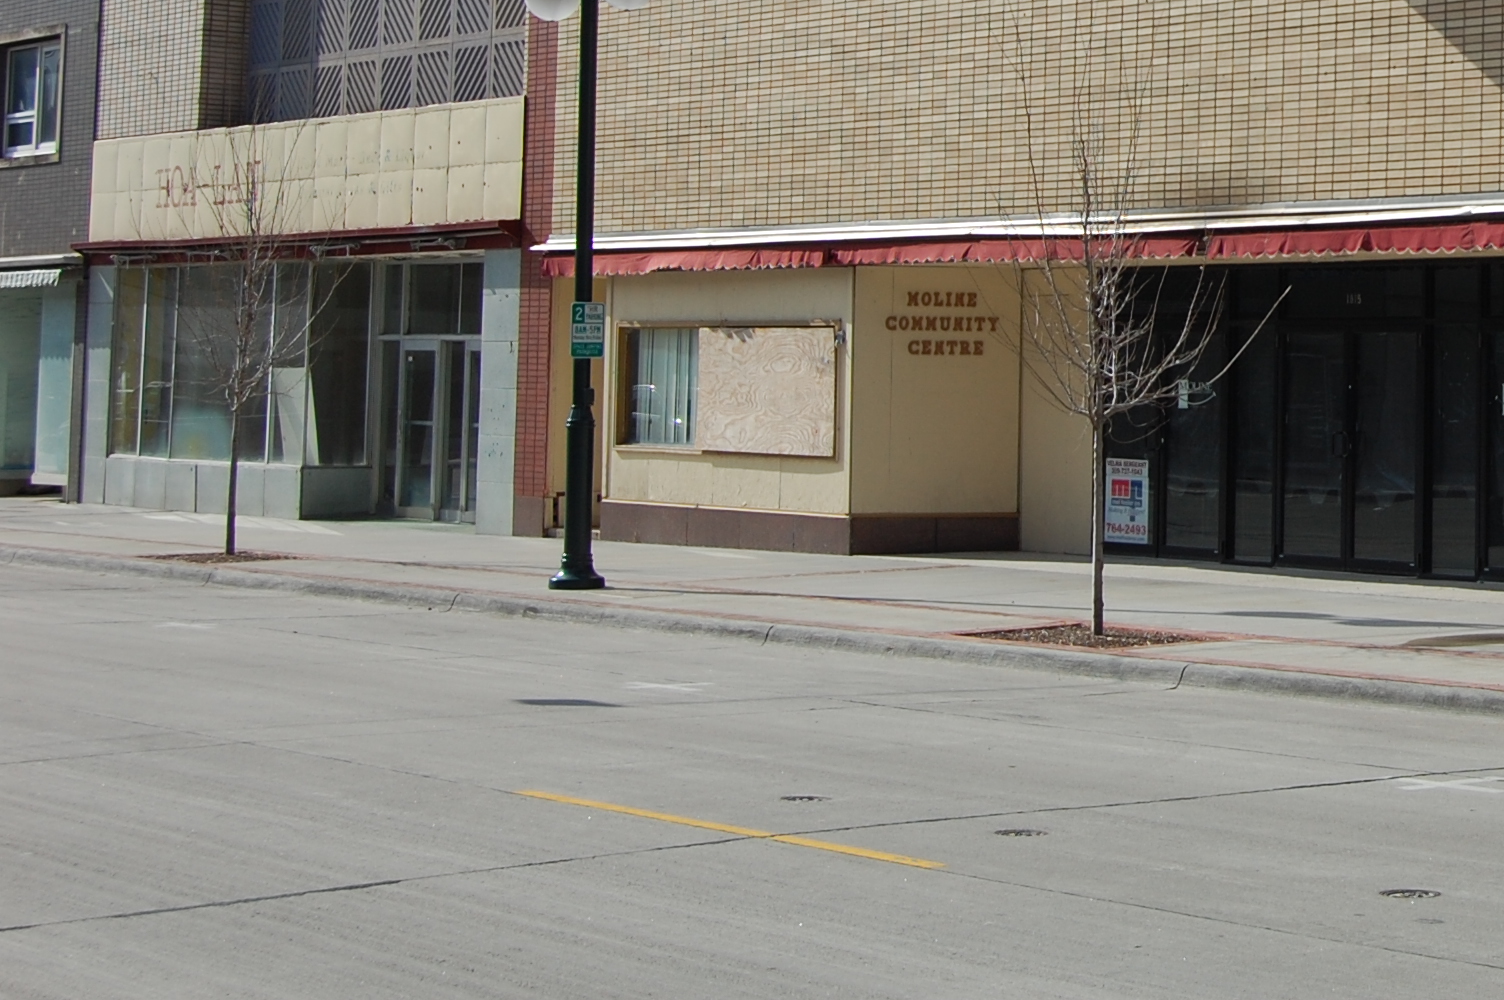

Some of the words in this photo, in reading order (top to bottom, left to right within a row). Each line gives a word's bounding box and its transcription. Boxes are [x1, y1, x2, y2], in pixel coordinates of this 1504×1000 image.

[907, 291, 977, 308] MOLINE
[575, 306, 583, 321] 2
[885, 315, 1000, 332] COMMUNITY
[907, 340, 984, 356] CENTRE
[1106, 522, 1146, 536] 764-2493
